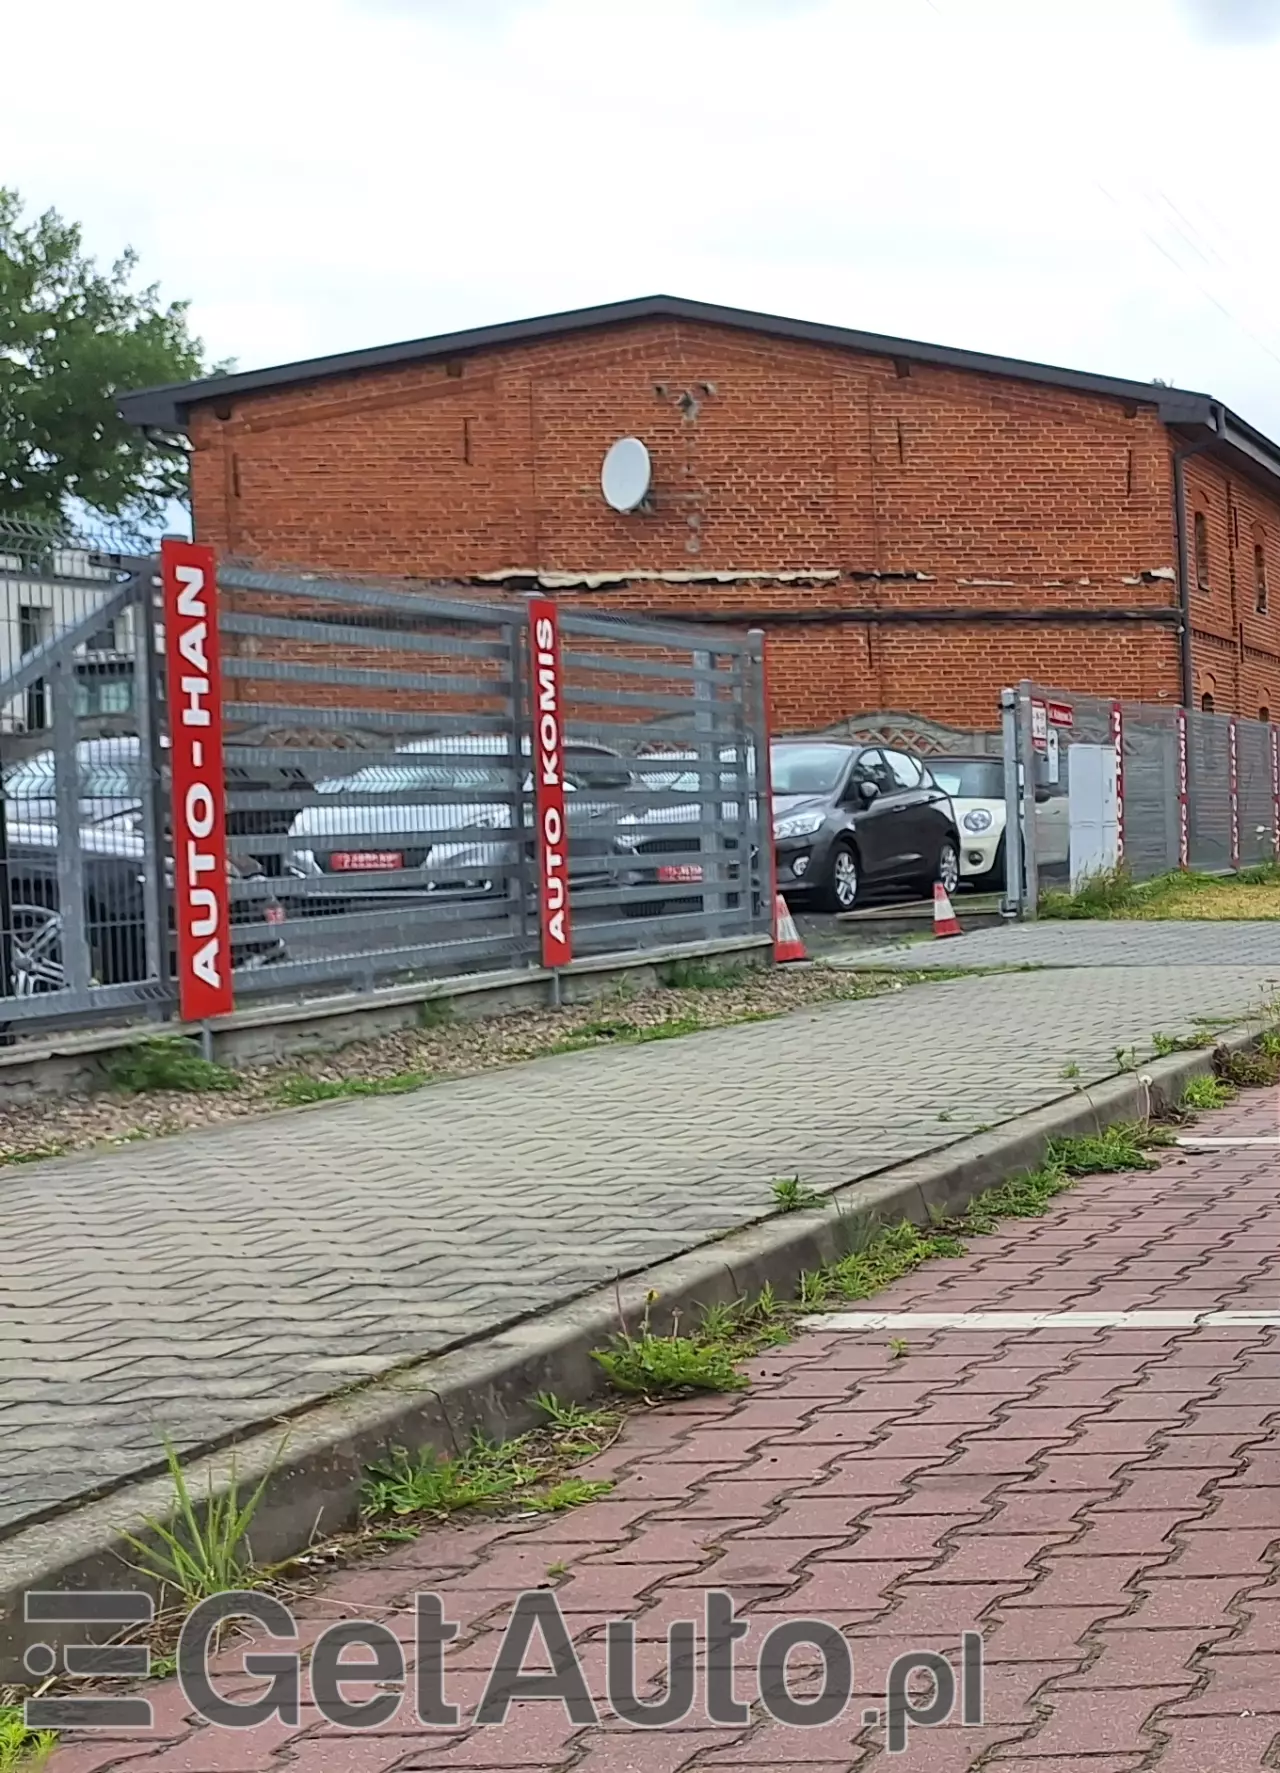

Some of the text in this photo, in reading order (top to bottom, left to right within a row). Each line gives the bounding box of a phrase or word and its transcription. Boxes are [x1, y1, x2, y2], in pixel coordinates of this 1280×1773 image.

[175, 564, 211, 727] HAN
[536, 617, 566, 944] AUTO KOMIS
[184, 782, 221, 989] AUTO
